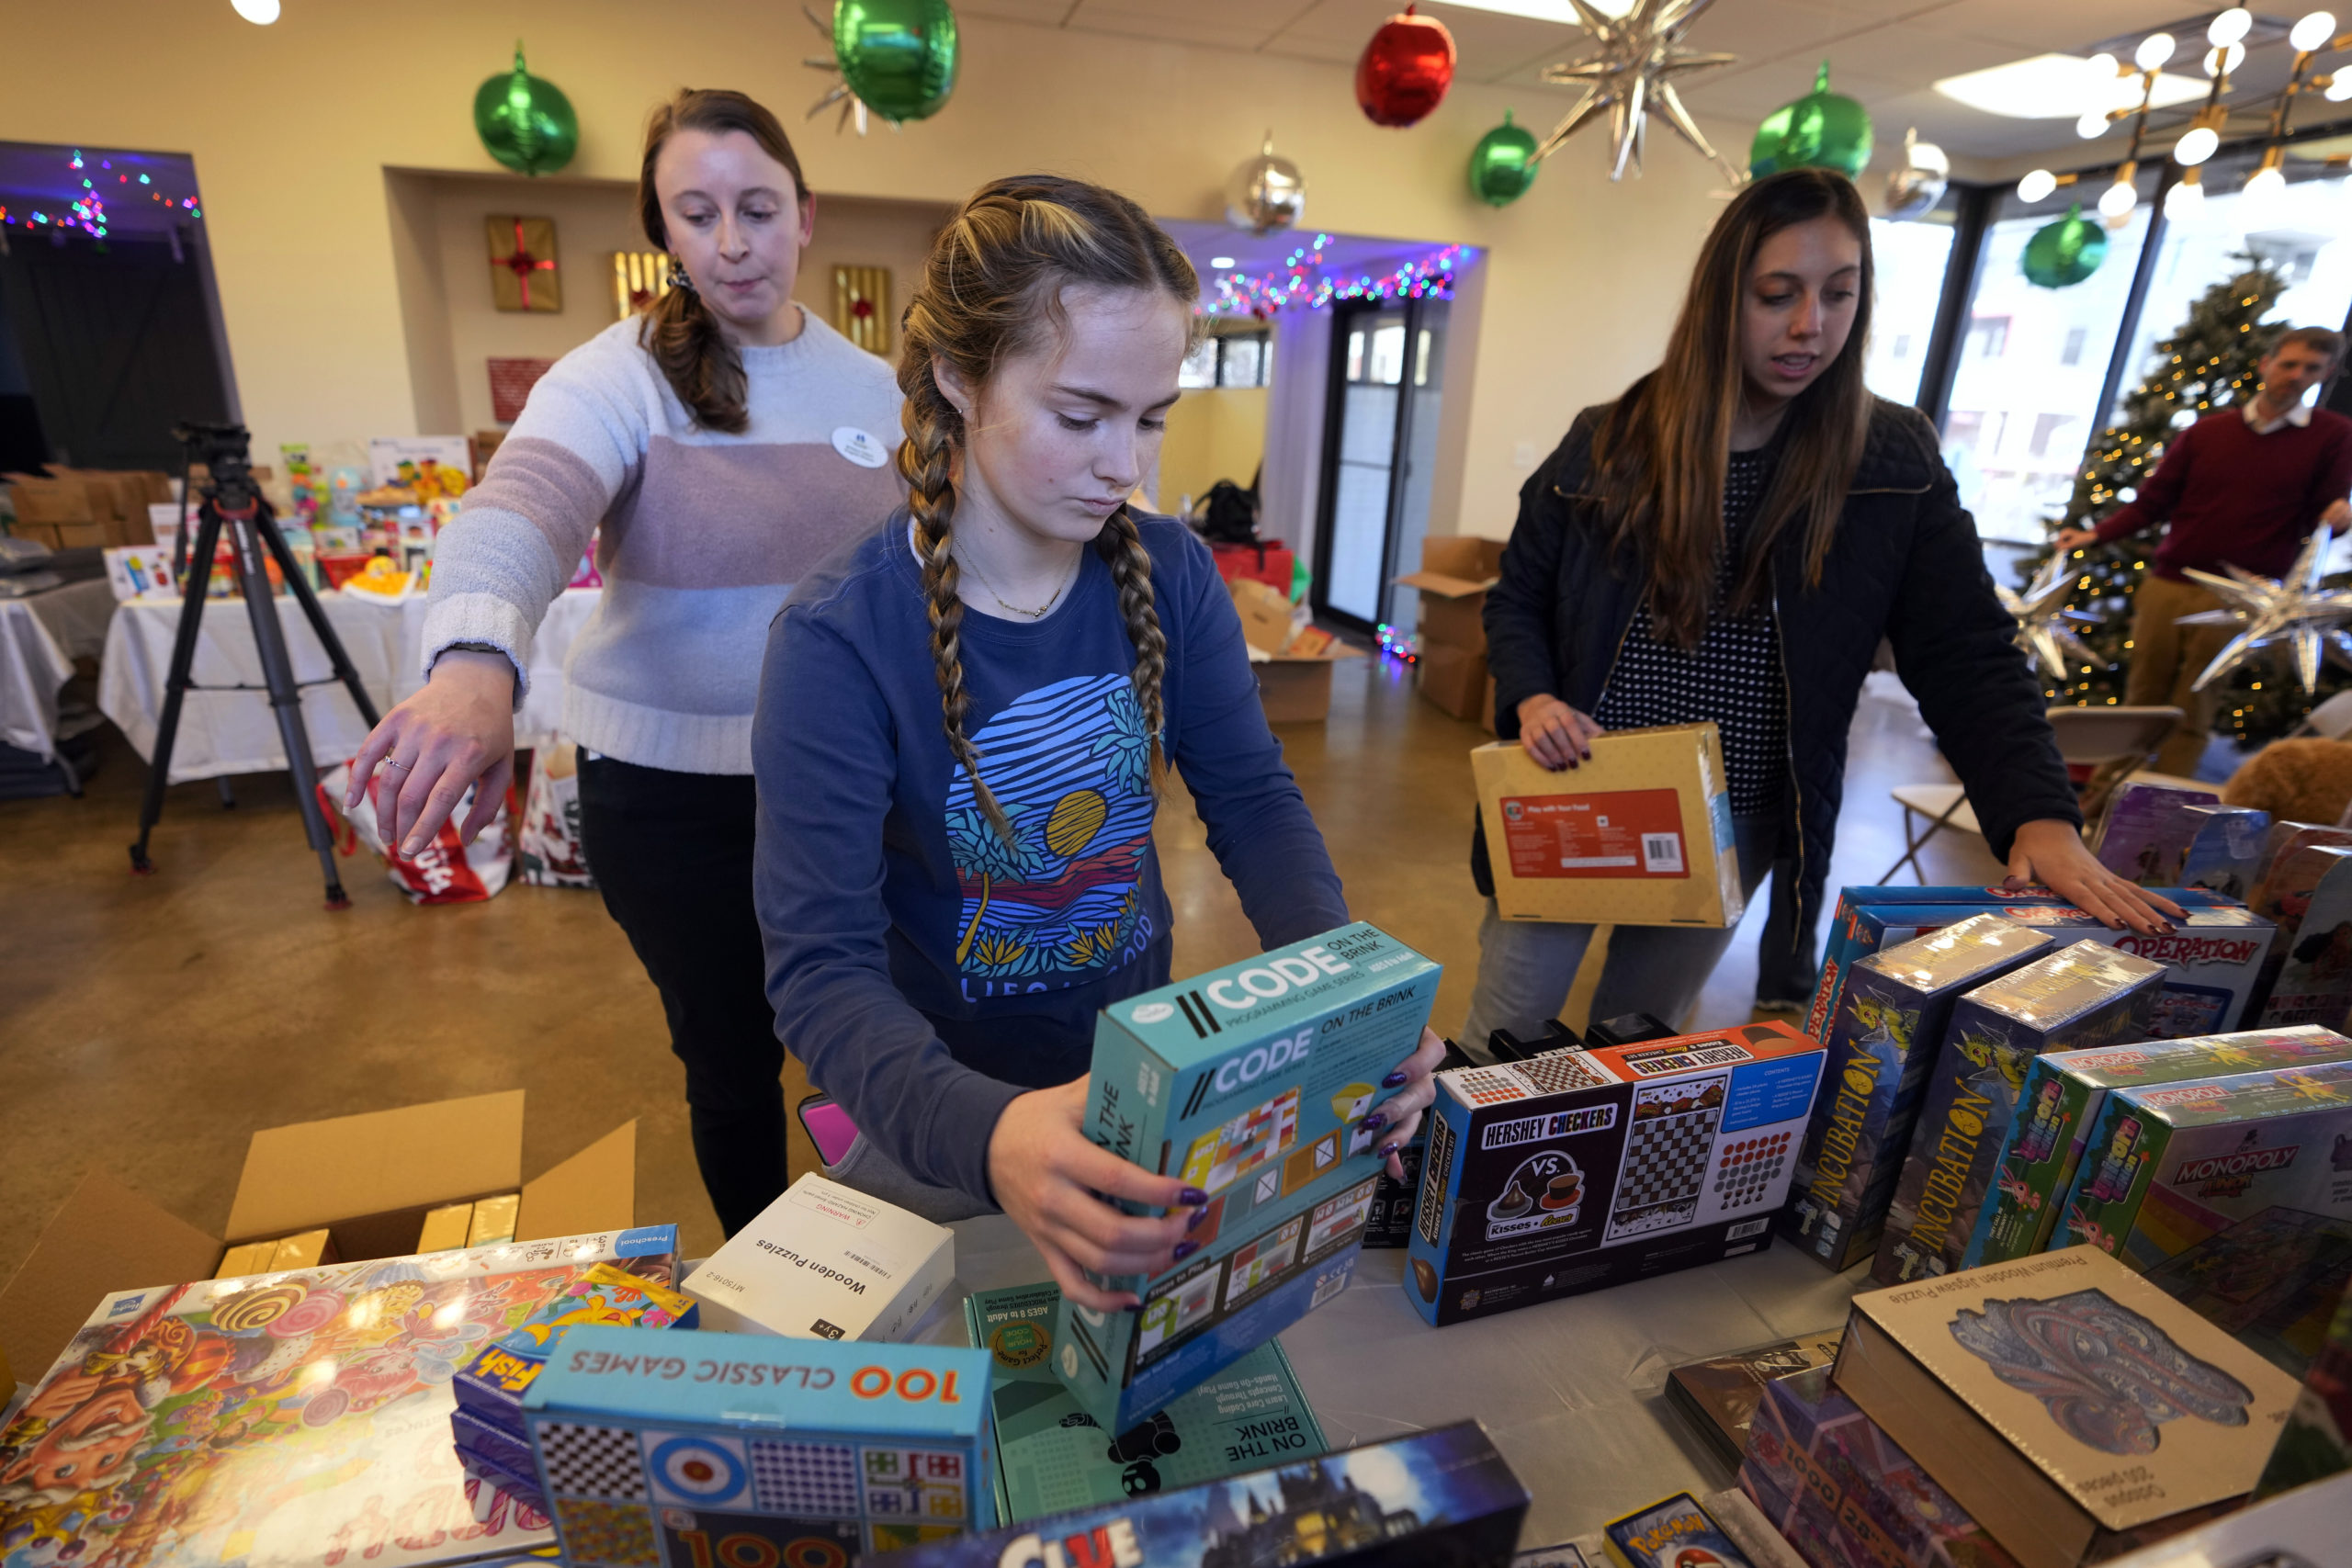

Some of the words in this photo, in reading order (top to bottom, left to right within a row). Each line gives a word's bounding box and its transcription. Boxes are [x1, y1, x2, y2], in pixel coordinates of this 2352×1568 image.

[1340, 941, 1385, 961] BRINK
[2112, 934, 2259, 965] OPERATION
[1207, 945, 1351, 1010] CODE
[1327, 937, 1350, 951] ON
[1350, 929, 1381, 943] THE
[1225, 988, 1306, 1028] PROGRAMMING
[1305, 980, 1332, 998] GAME
[1331, 971, 1366, 987] SERIES
[1808, 956, 1839, 1039] PERATION
[1215, 1027, 1314, 1093] CODE
[1321, 1014, 1344, 1034] ON
[1349, 1004, 1374, 1021] THE
[1376, 985, 1417, 1011] BRINK
[1633, 1055, 1698, 1074] CHECKERS
[1693, 1046, 1750, 1066] HERSHEY
[2067, 1052, 2153, 1069] MONOPOLY
[2143, 1086, 2230, 1106] MONOPOLY
[1099, 1085, 1120, 1131] THE
[1485, 1117, 1546, 1147] HERSHEY
[1548, 1107, 1614, 1136] CHECKERS
[1811, 1038, 1883, 1209] INCUBATION
[1114, 1121, 1136, 1165] INK
[1532, 1157, 1561, 1177] VS.
[1910, 1077, 1994, 1254] INCUBATION
[2177, 1147, 2299, 1182] MONOPOLY
[1420, 1176, 1435, 1239] HERSHEY
[1429, 1115, 1445, 1183] CHECKERS
[815, 1203, 851, 1222] WARNING
[621, 1235, 669, 1247] Preschool
[756, 1239, 809, 1269] Puzzles
[2030, 1255, 2088, 1272] Premium
[706, 1270, 745, 1293] MT5016-2
[808, 1259, 866, 1296] Wooden
[1937, 1277, 1979, 1294] Jigsaw
[1978, 1266, 2035, 1285] Wooden
[1889, 1288, 1938, 1303] Puzzle
[987, 1312, 1008, 1323] Adult
[1028, 1306, 1048, 1316] AGES
[998, 1351, 1021, 1366] Game
[1023, 1344, 1047, 1365] Perfect
[474, 1348, 546, 1392] Fish
[567, 1350, 686, 1382] GAMES
[694, 1358, 836, 1390] CLASSIC
[850, 1365, 961, 1405] 100
[1217, 1381, 1239, 1390] Game
[1240, 1374, 1278, 1386] Hands-On
[1248, 1384, 1283, 1396] Concepts
[1198, 1385, 1216, 1396] Play!
[1216, 1391, 1247, 1404] Through
[1265, 1394, 1288, 1404] Learn
[1217, 1403, 1246, 1414] Coding
[1247, 1399, 1264, 1408] Core
[1235, 1416, 1300, 1441] BRINK
[1225, 1441, 1269, 1461] THE
[1272, 1433, 1306, 1451] ON
[1787, 1445, 1835, 1503] 1000
[677, 1529, 848, 1568] 100
